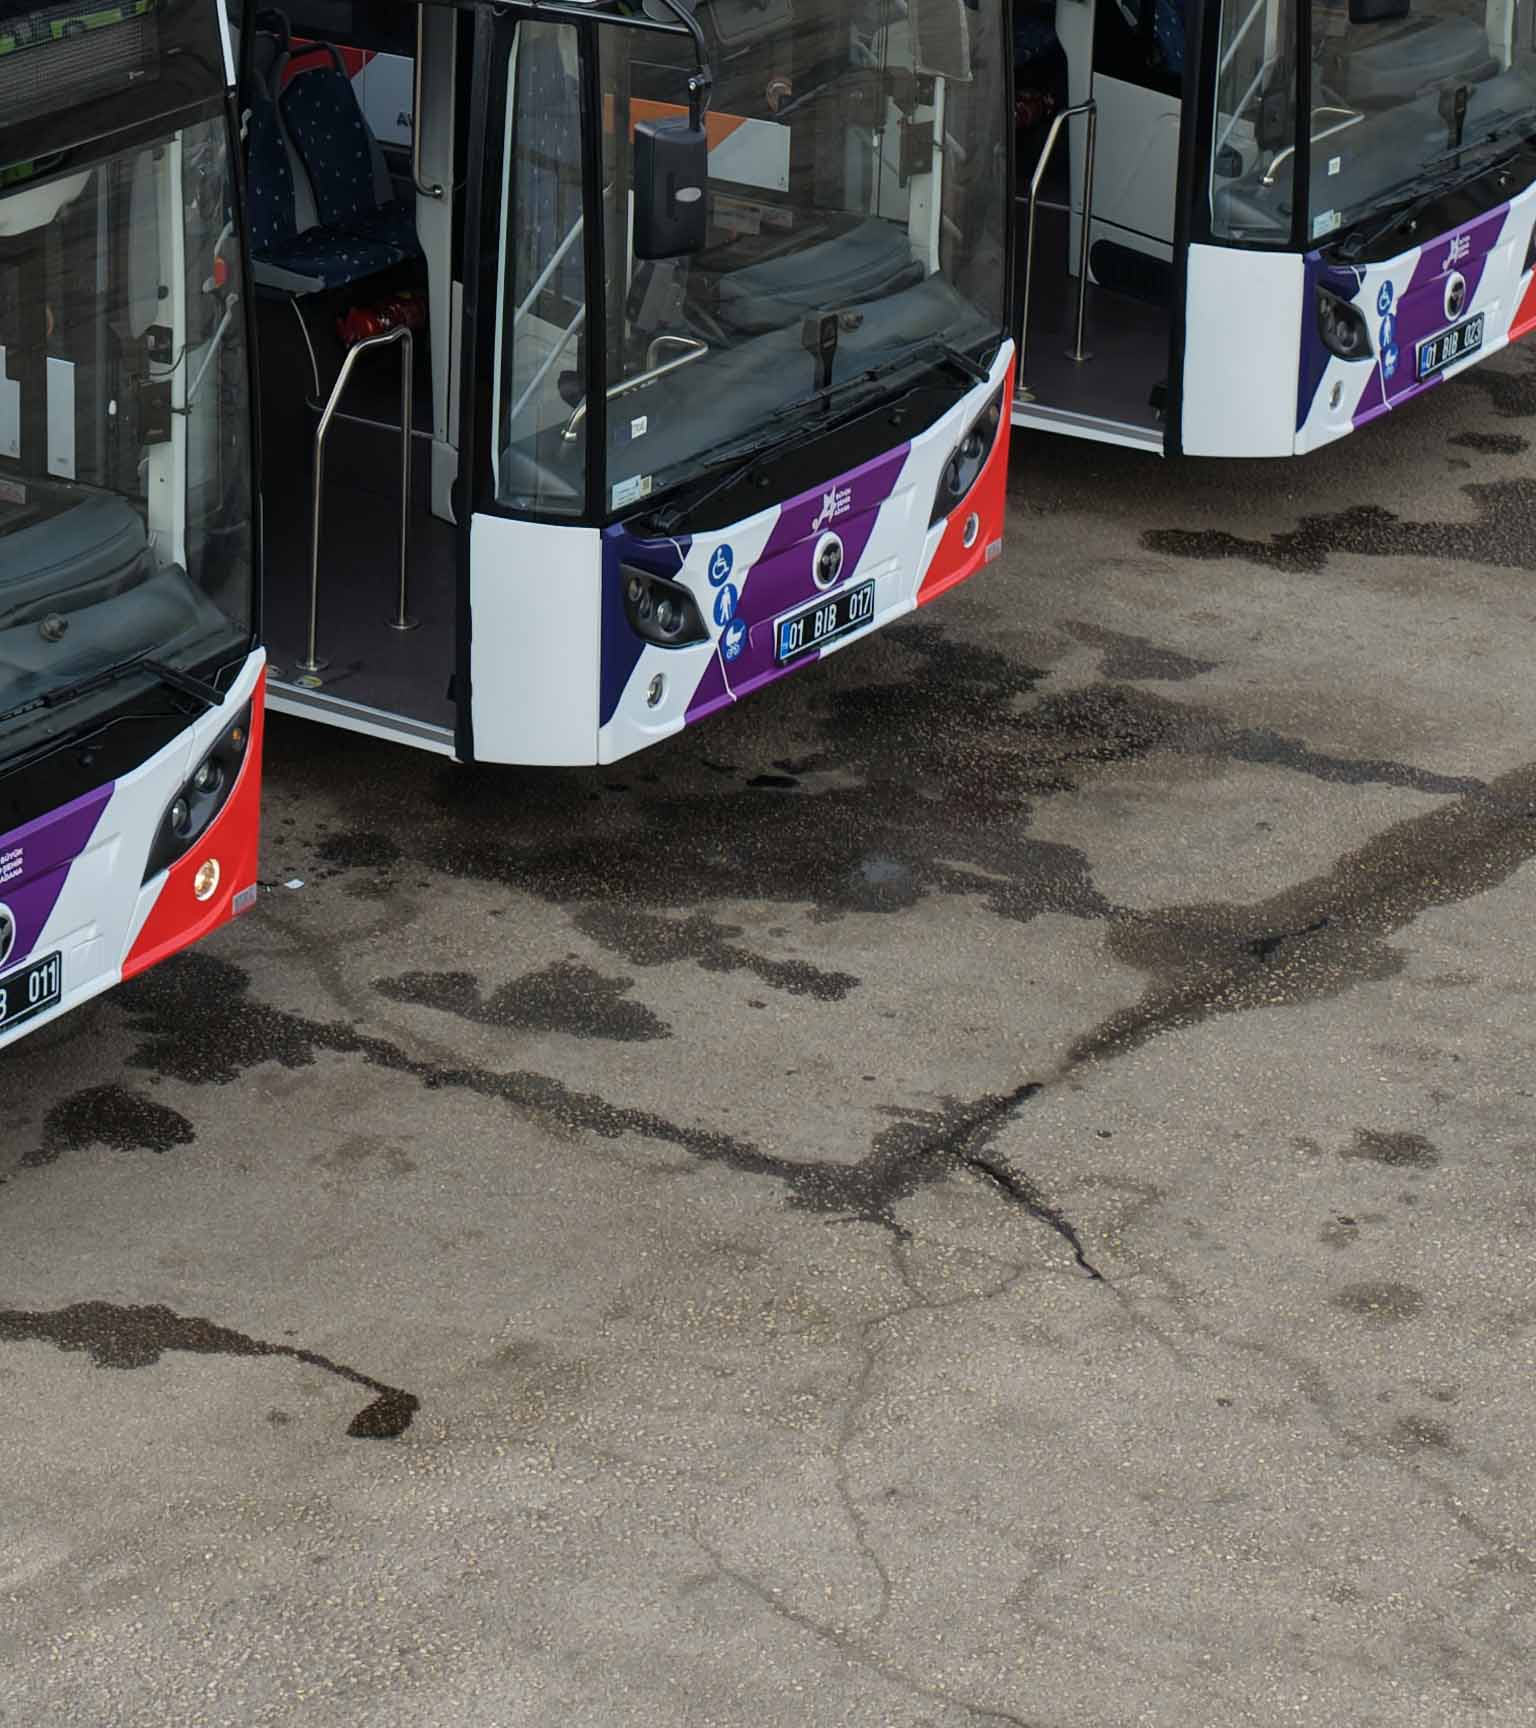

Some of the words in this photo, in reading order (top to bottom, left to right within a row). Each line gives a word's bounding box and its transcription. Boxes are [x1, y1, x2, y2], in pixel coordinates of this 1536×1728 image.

[789, 619, 804, 650] 01
[814, 604, 837, 639] BIB
[849, 583, 872, 620] 017
[28, 960, 57, 1002] 011
